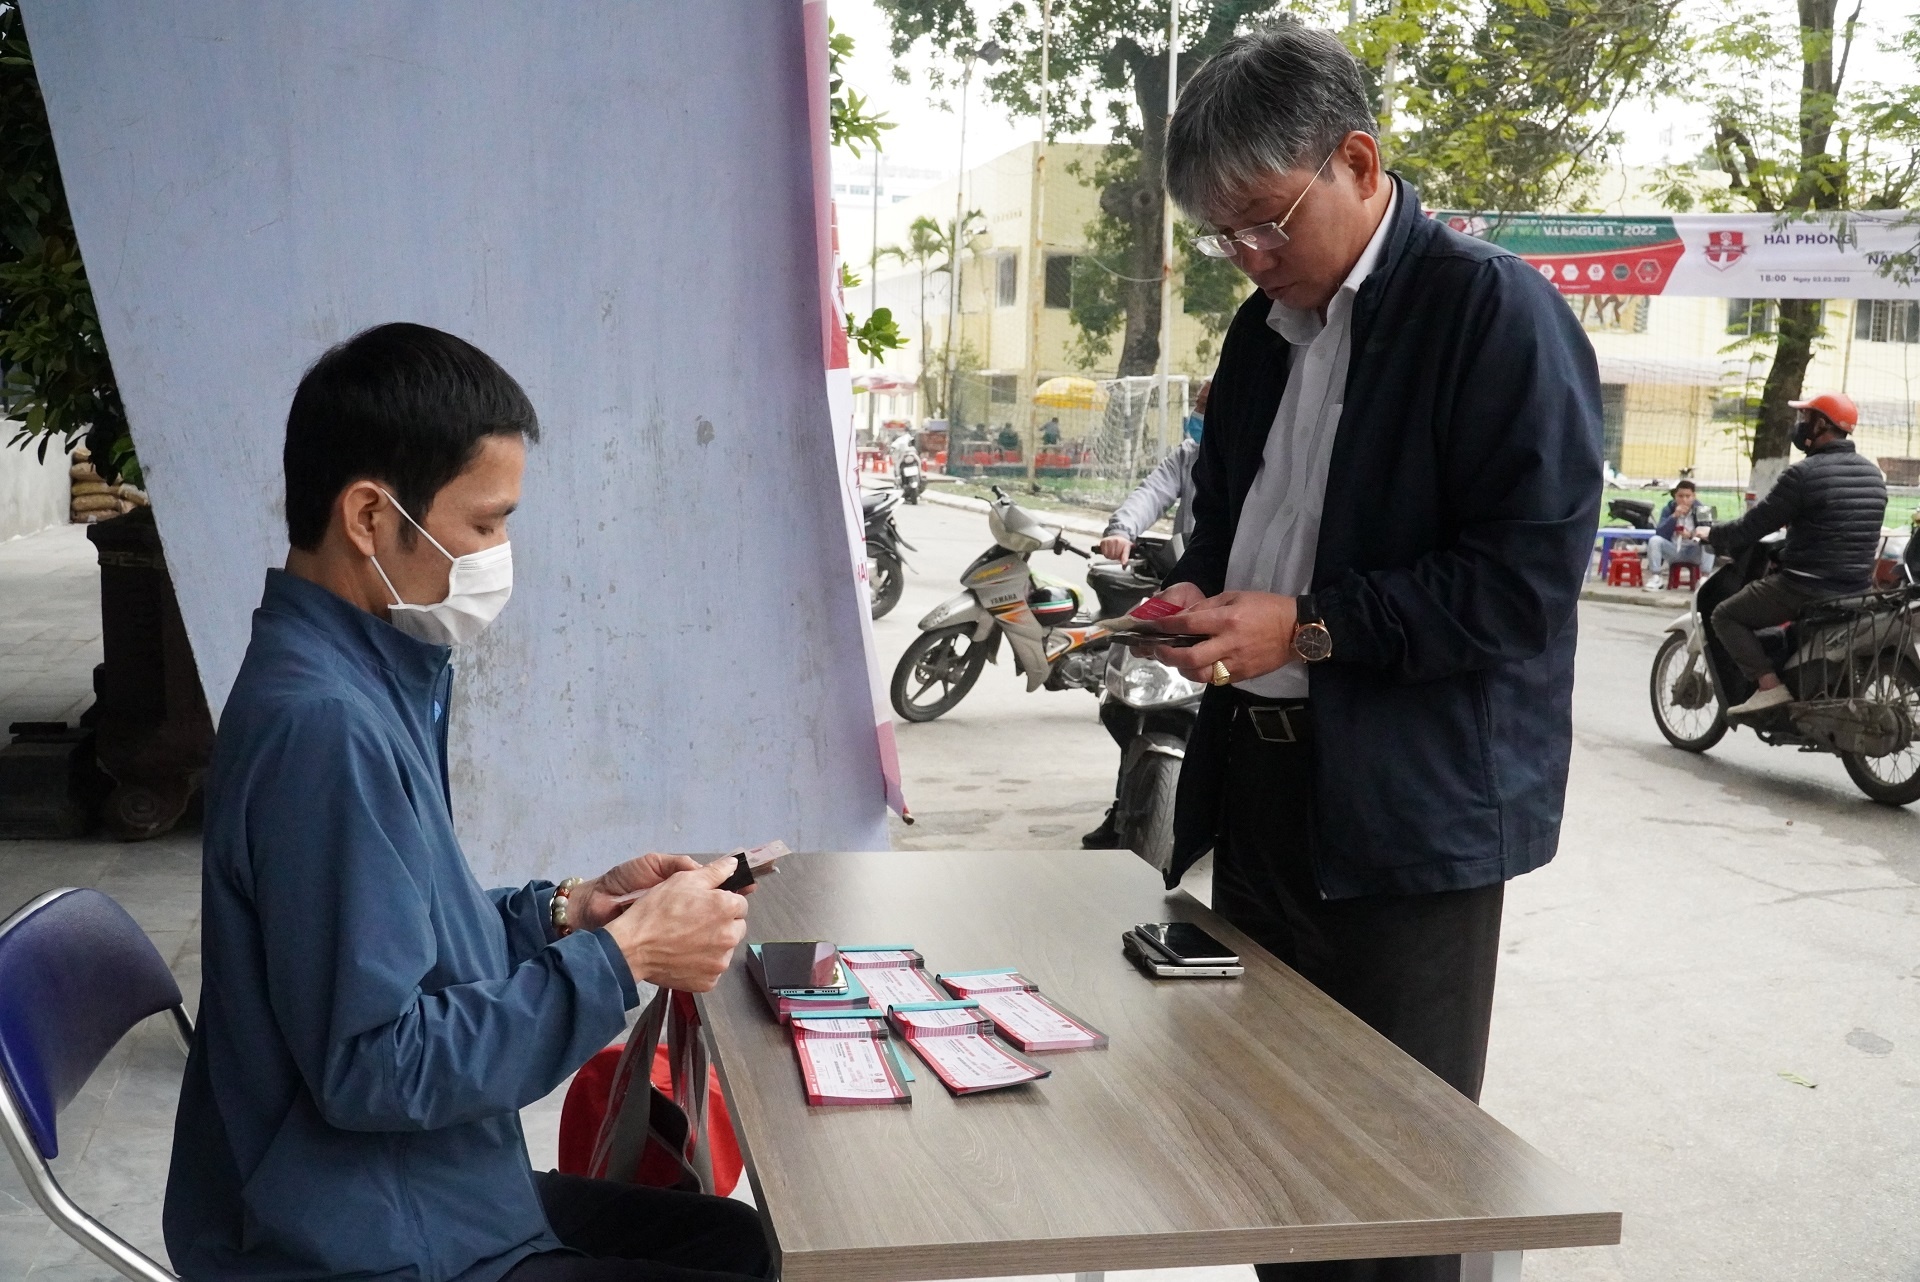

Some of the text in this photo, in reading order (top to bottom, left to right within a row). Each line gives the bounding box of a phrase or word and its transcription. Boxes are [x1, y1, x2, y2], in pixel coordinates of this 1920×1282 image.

[1607, 226, 1615, 236] 1
[1623, 226, 1657, 236] 2022
[1760, 275, 1787, 283] 18:00
[991, 593, 1018, 605] YAMAHA
